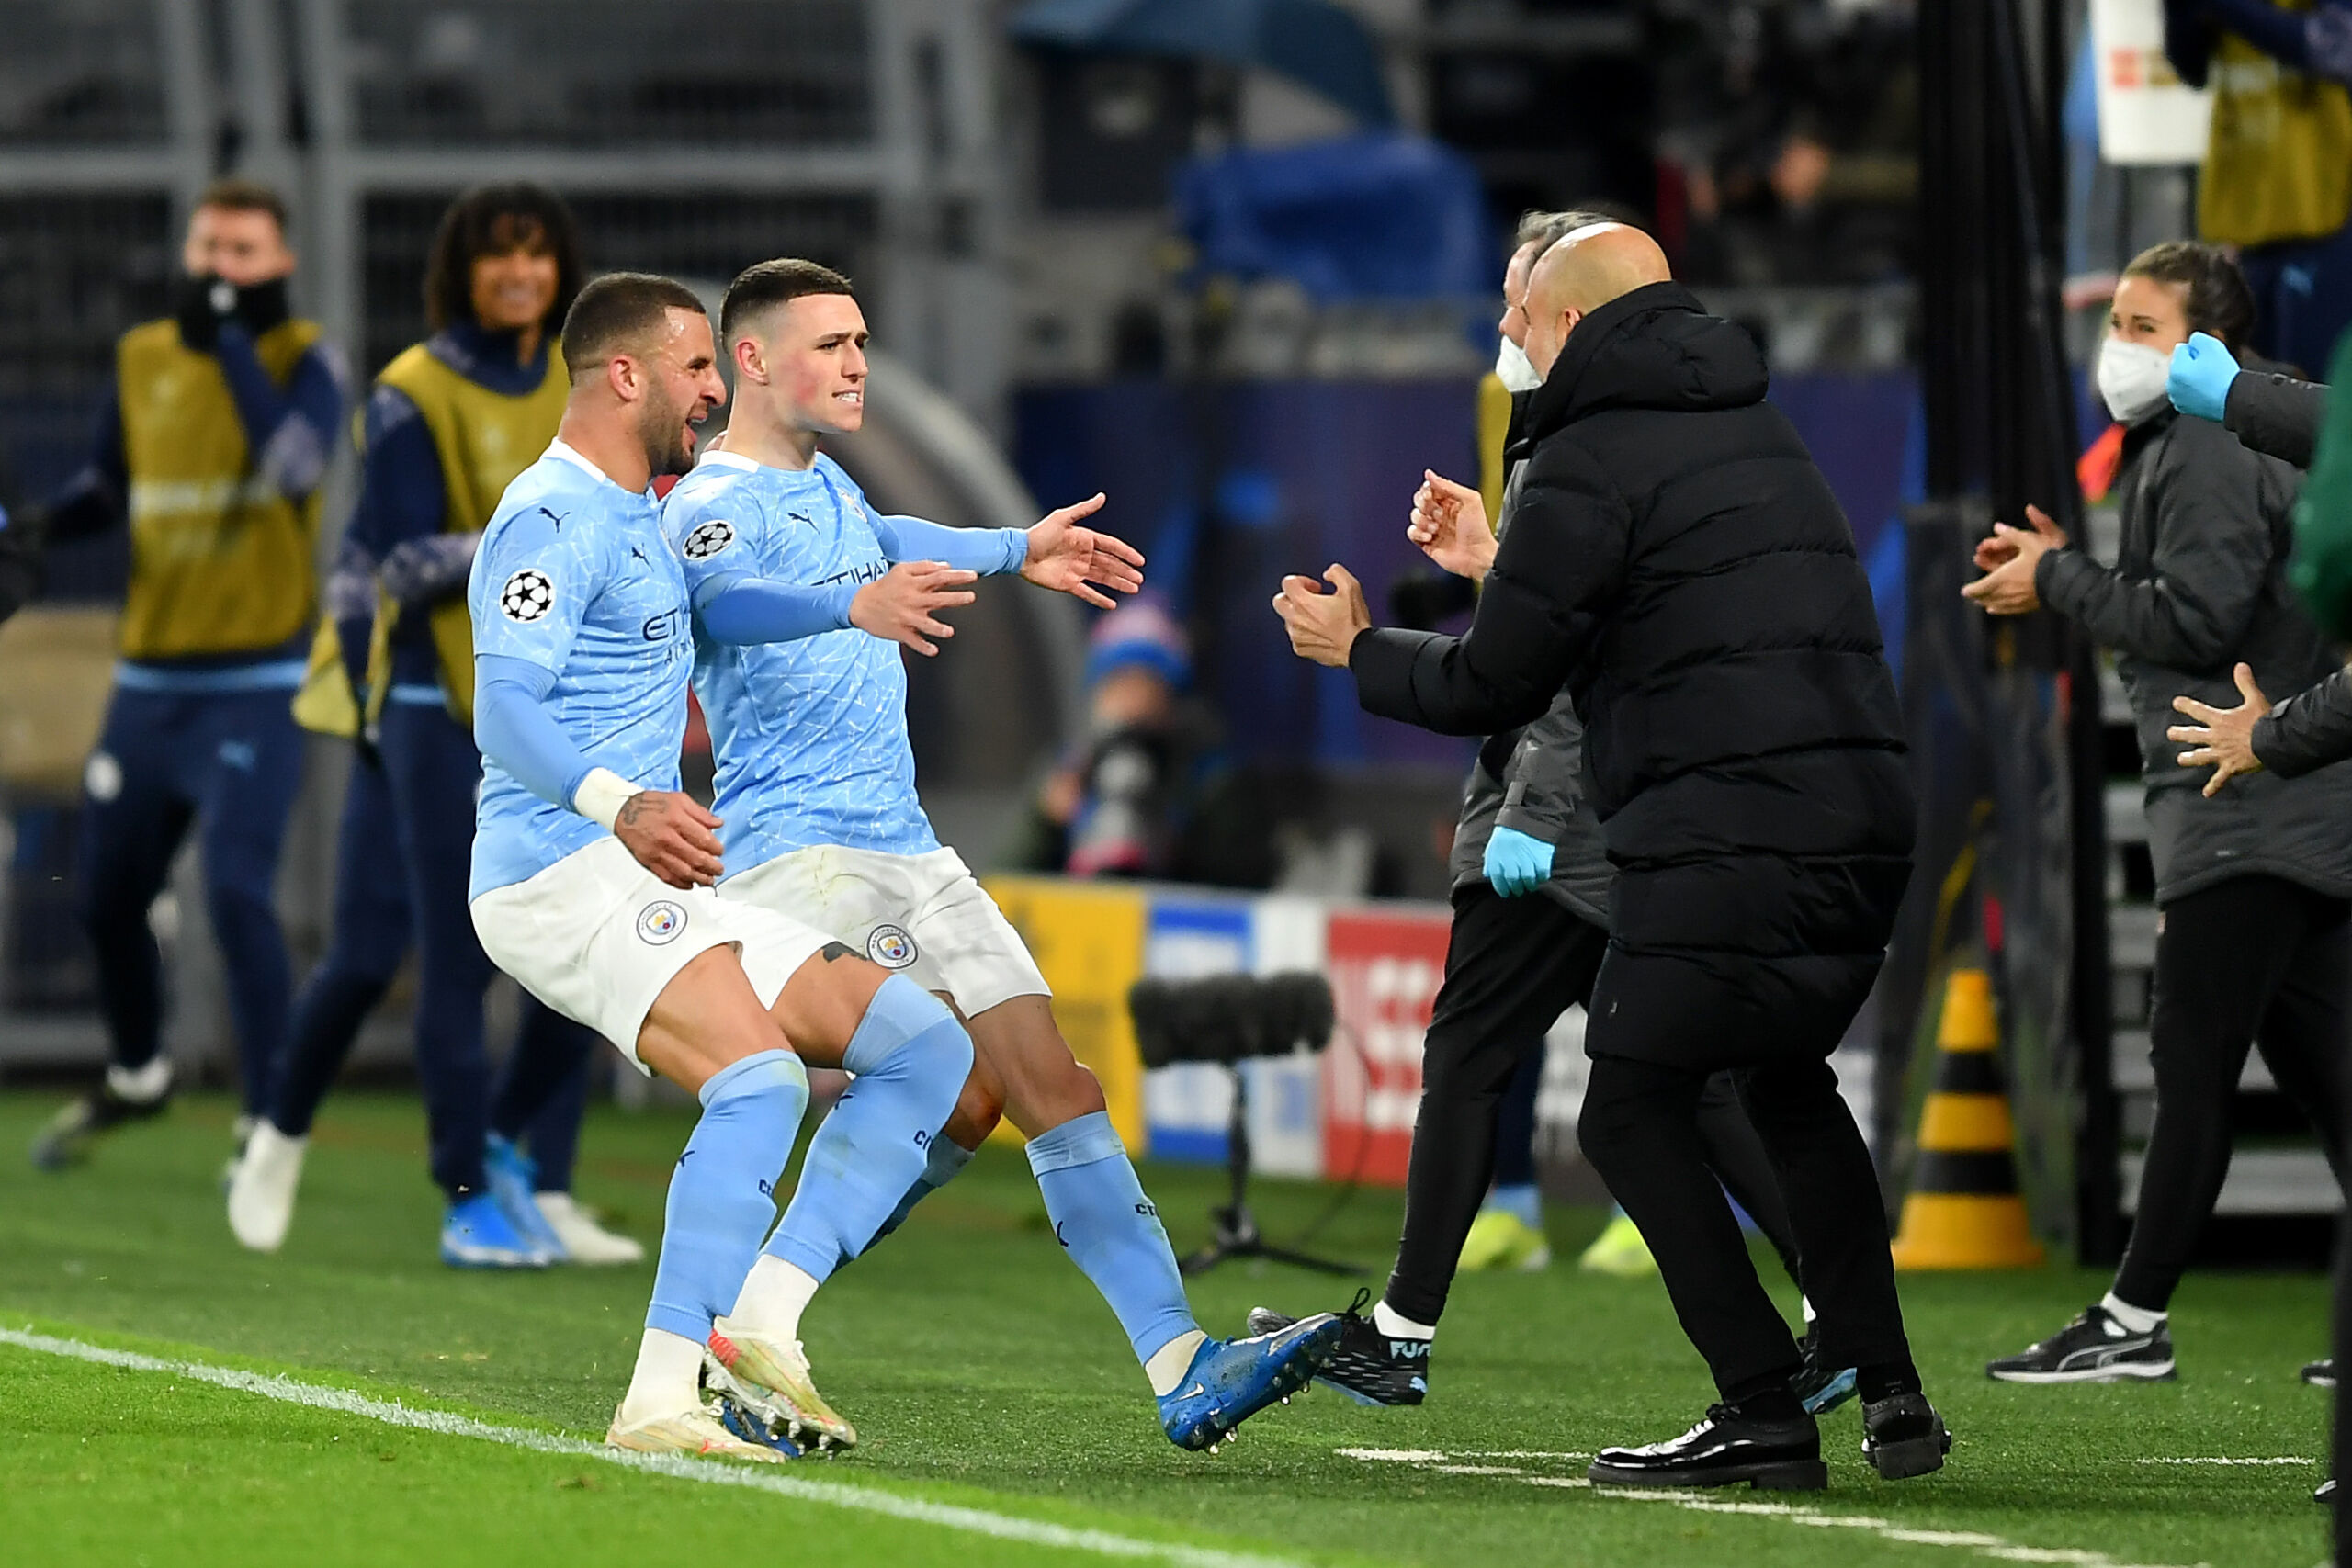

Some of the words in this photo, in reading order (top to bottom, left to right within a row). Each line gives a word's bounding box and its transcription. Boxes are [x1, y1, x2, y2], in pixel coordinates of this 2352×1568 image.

[642, 607, 686, 642] ET
[913, 1130, 933, 1150] CI
[759, 1179, 773, 1198] CI
[1135, 1203, 1155, 1216] CI
